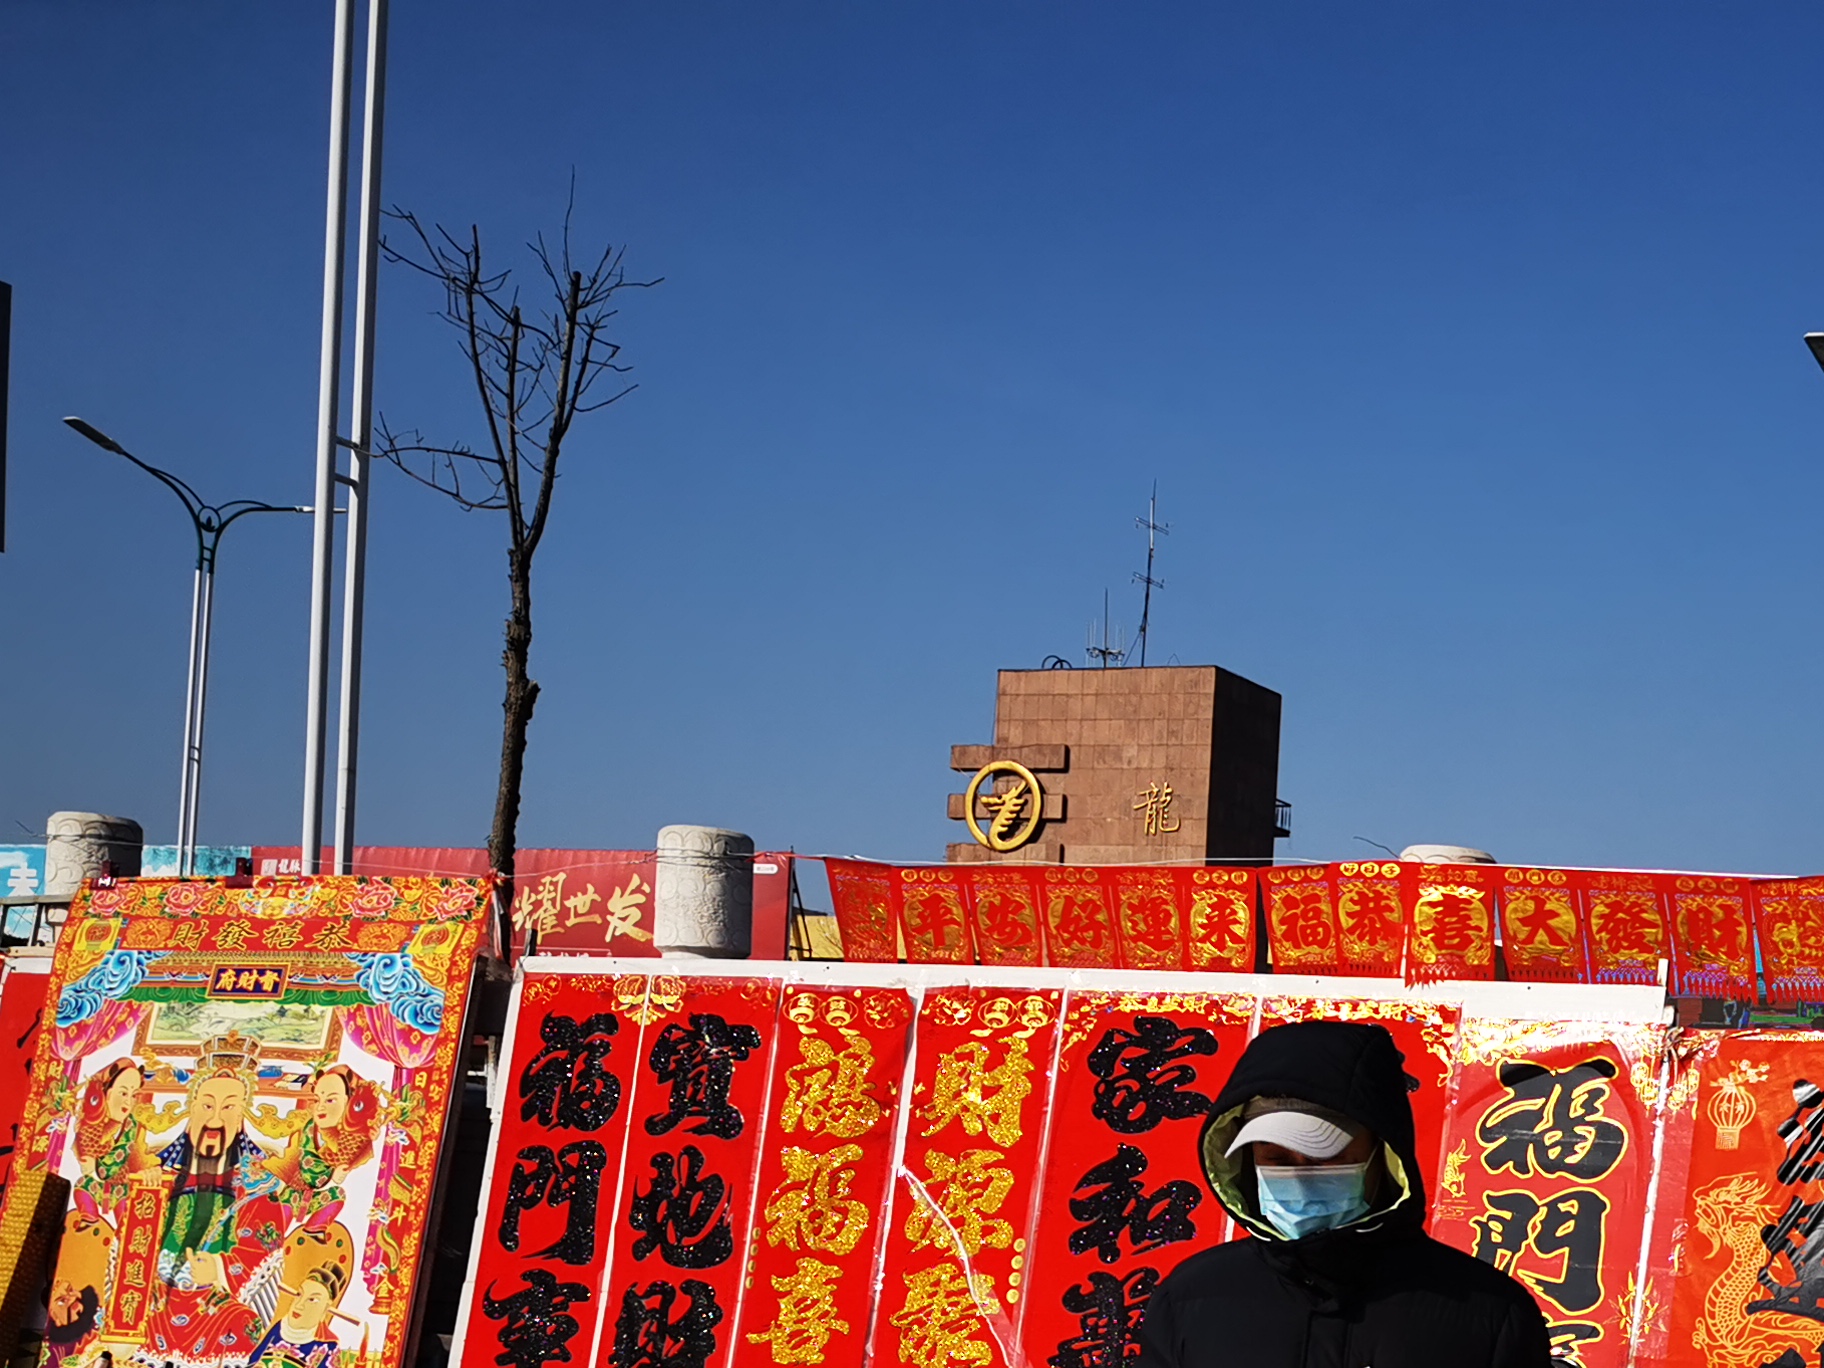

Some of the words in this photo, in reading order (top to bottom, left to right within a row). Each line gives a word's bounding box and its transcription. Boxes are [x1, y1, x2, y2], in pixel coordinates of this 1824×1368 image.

[1132, 782, 1181, 836] 龍
[512, 872, 655, 945] 耀世发
